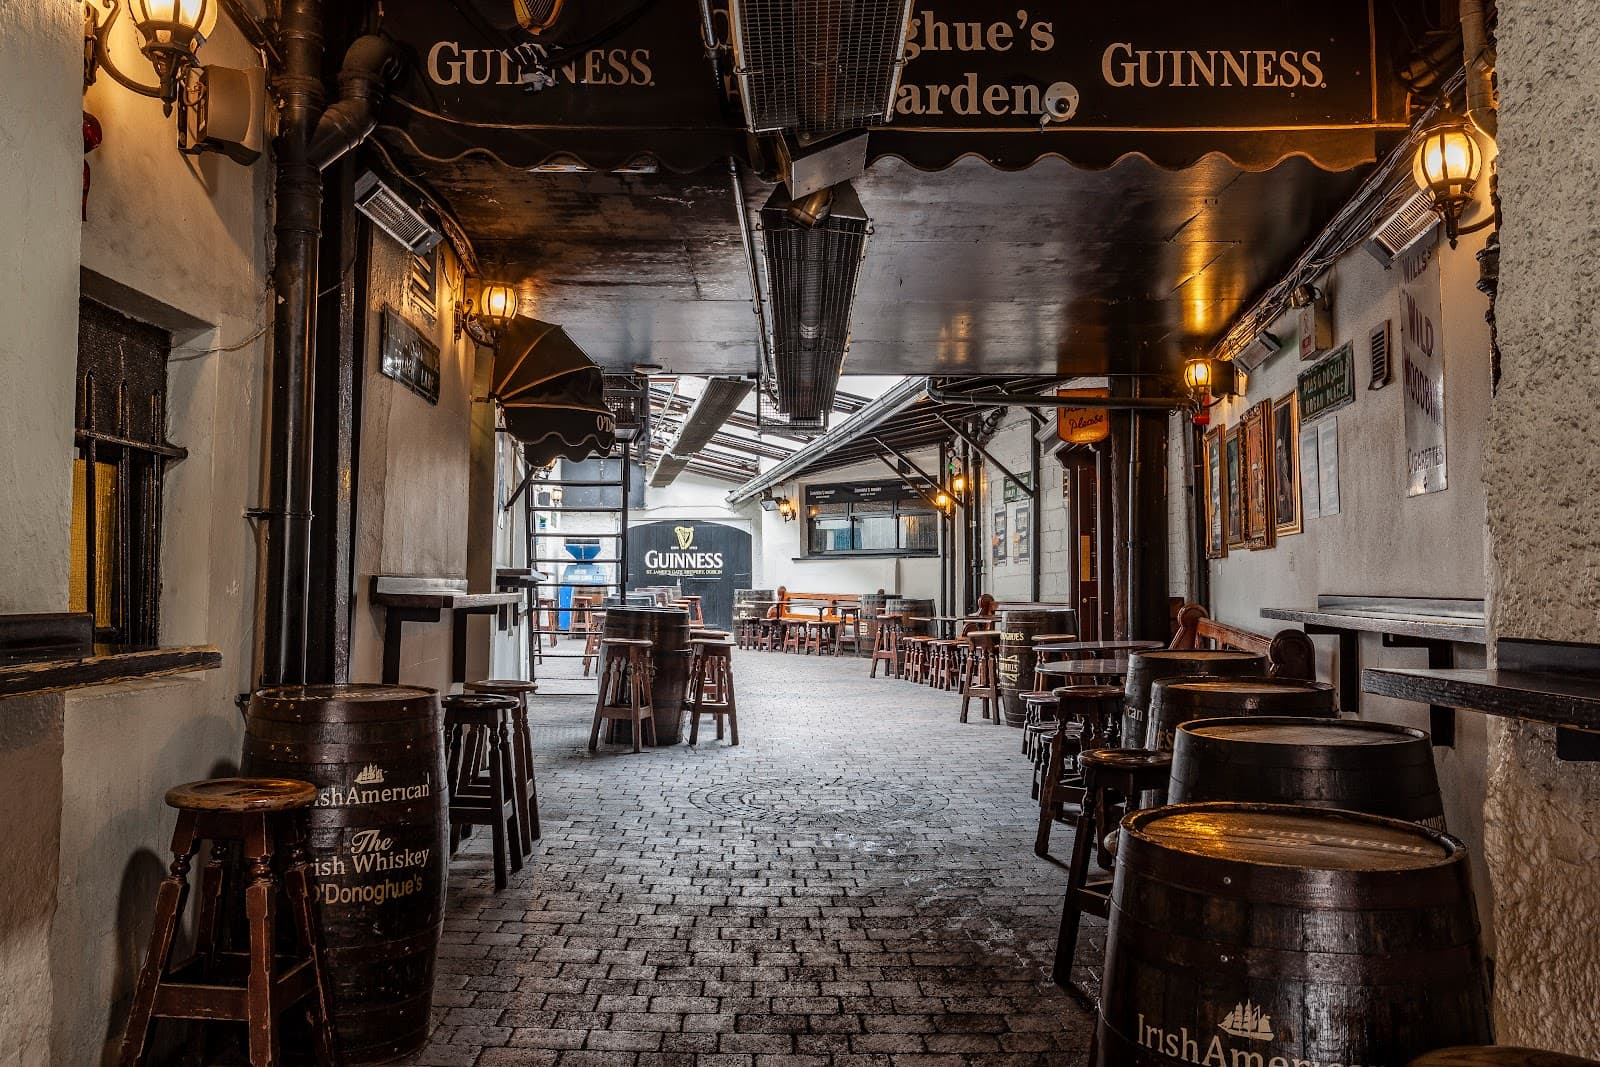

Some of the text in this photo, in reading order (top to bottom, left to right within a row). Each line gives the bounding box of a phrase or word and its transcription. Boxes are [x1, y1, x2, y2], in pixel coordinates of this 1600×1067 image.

[644, 549, 723, 568] GUINNESS
[305, 784, 430, 807] ishAmerican
[350, 829, 393, 854] The
[309, 848, 430, 877] ish Whiskey
